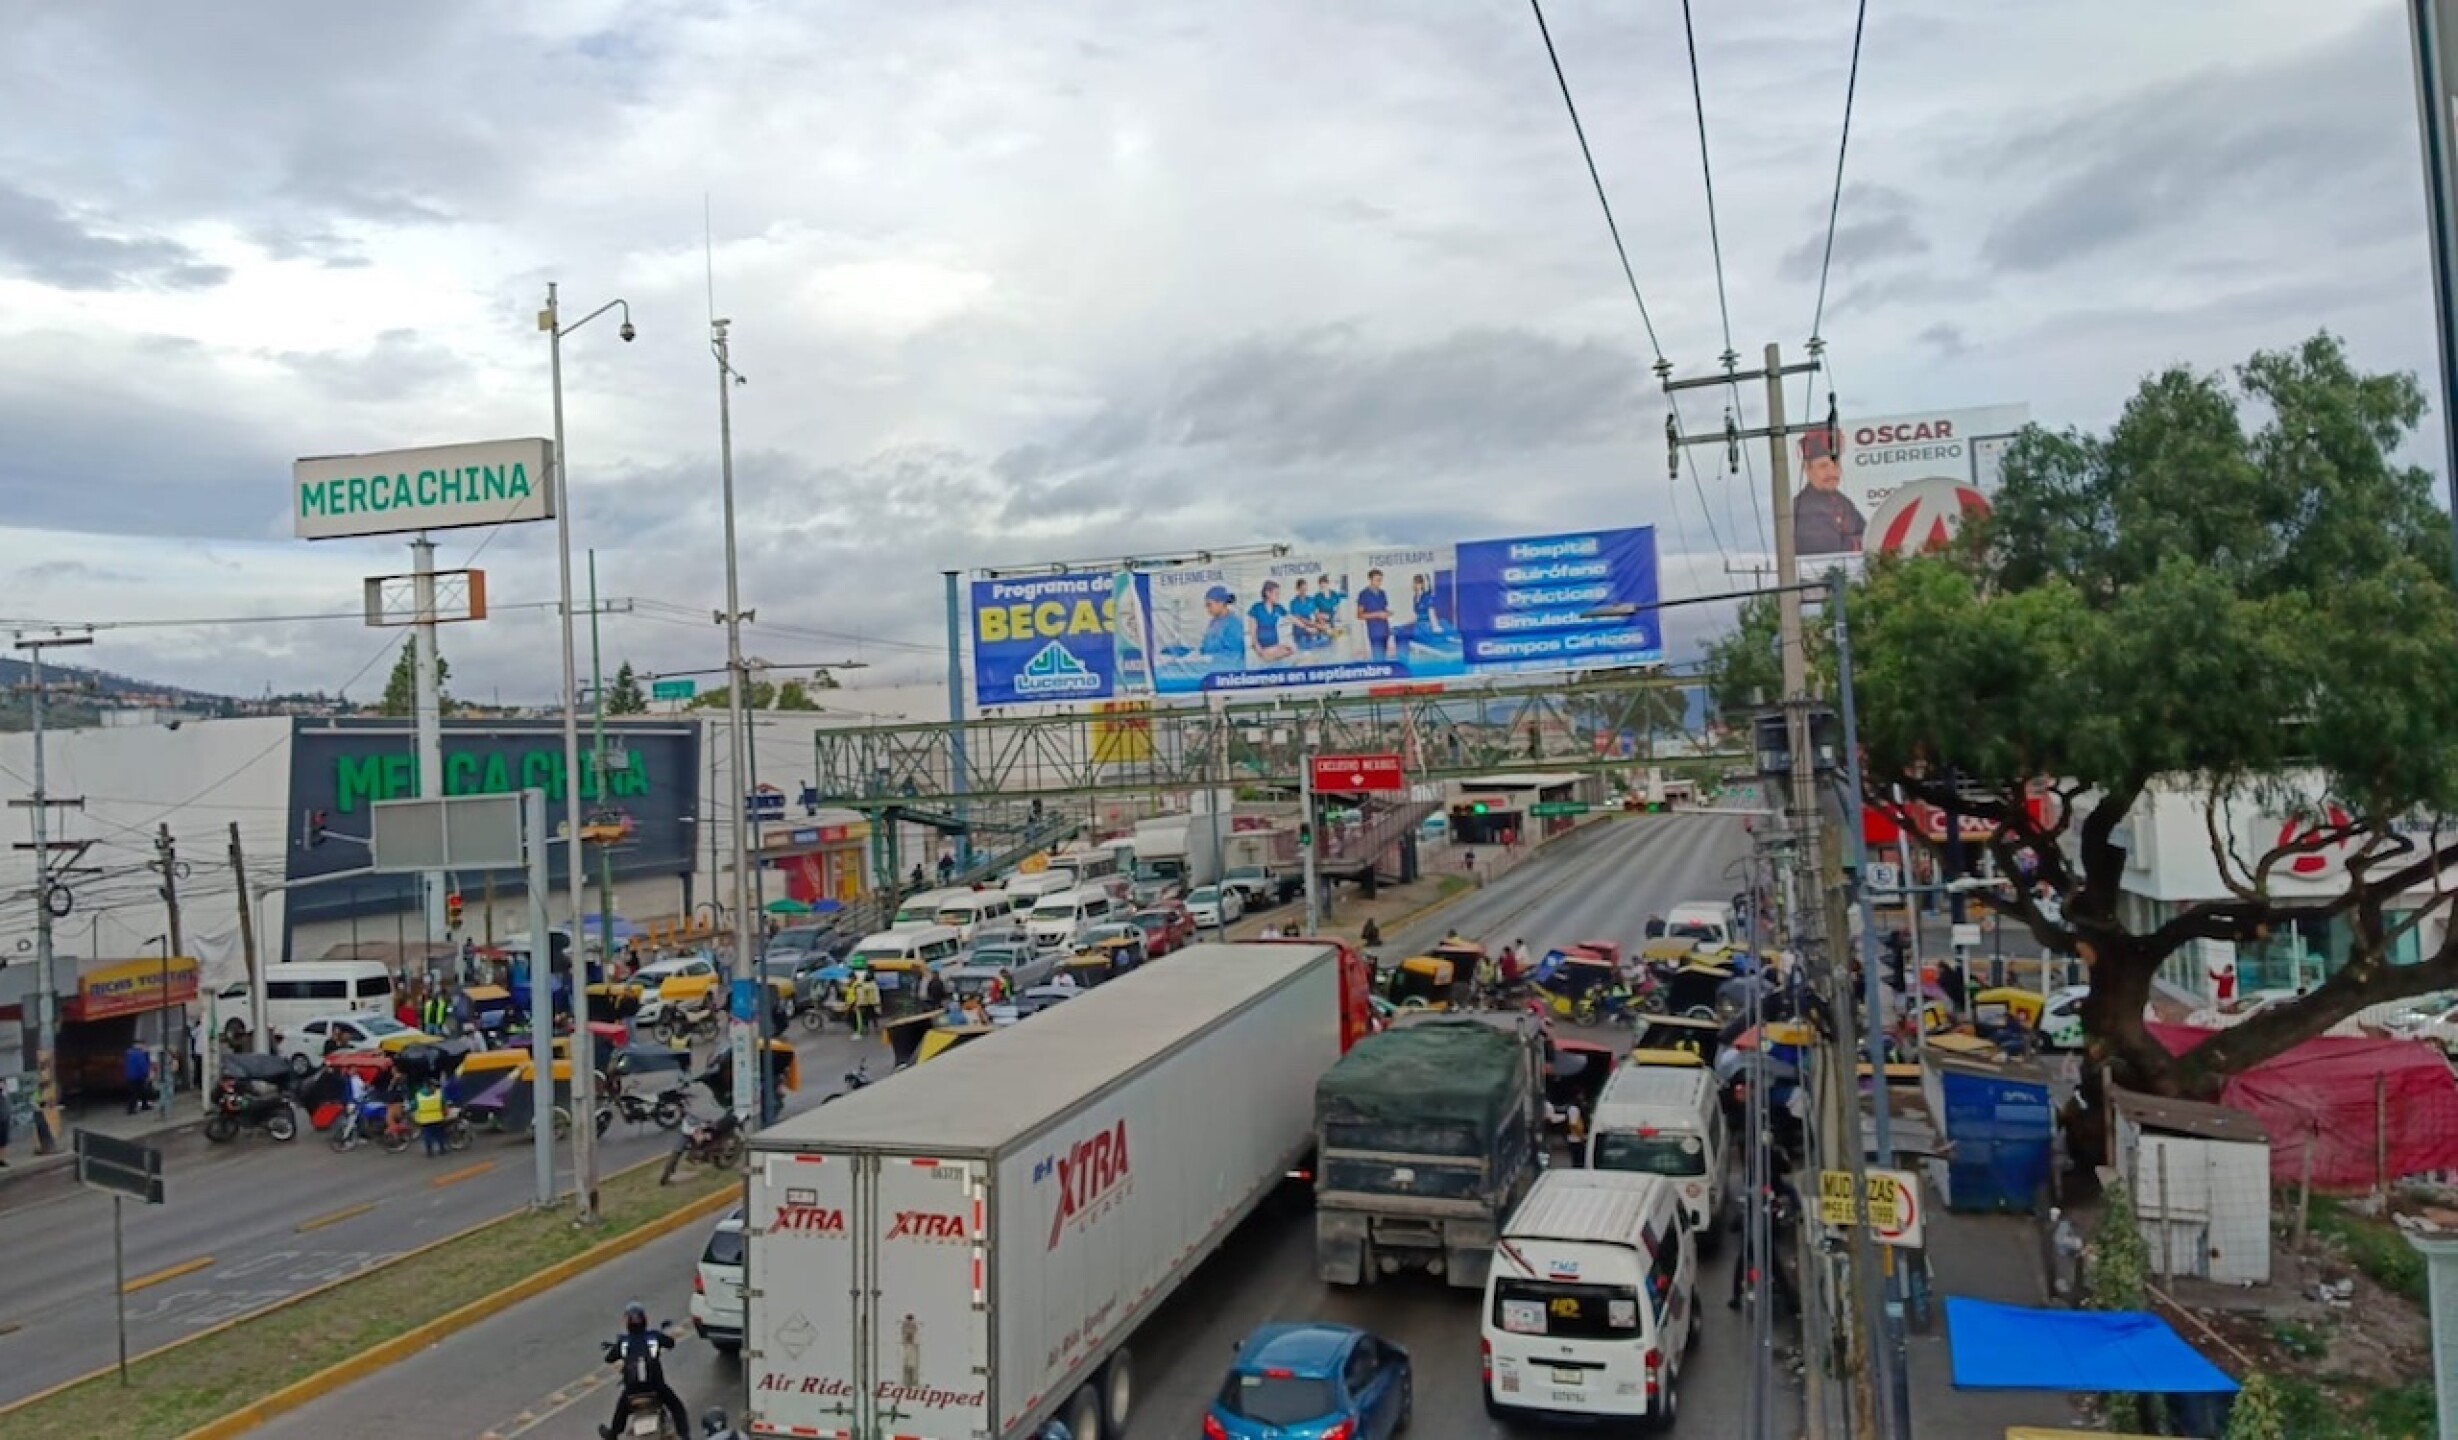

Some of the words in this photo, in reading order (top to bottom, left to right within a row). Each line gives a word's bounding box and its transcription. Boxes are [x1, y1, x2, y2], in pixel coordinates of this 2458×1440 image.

[1855, 420, 1953, 446] OSCAR
[1855, 445, 1962, 466] GUERRERO
[301, 462, 531, 518] MERCACHINA
[1369, 550, 1434, 567] FISIOTERAPIA
[1511, 538, 1597, 560] Hospital
[1504, 563, 1608, 582] Quirófano
[993, 580, 1089, 600] Programa
[1477, 638, 1561, 656] Campos
[1565, 631, 1645, 649] Clínicos
[1018, 677, 1097, 692] Lucerna
[1215, 672, 1285, 687] Iniciamos
[1288, 671, 1306, 683] en
[1309, 664, 1392, 683] septiembre
[336, 750, 510, 813] MECA
[1047, 1118, 1129, 1252] XTRA
[1823, 1174, 1894, 1202] MUDZAS
[768, 1204, 844, 1234] XTRA
[886, 1210, 966, 1241] XTRA
[757, 1373, 796, 1392] Air
[800, 1377, 853, 1396] Ride
[877, 1381, 983, 1408] Equipped
